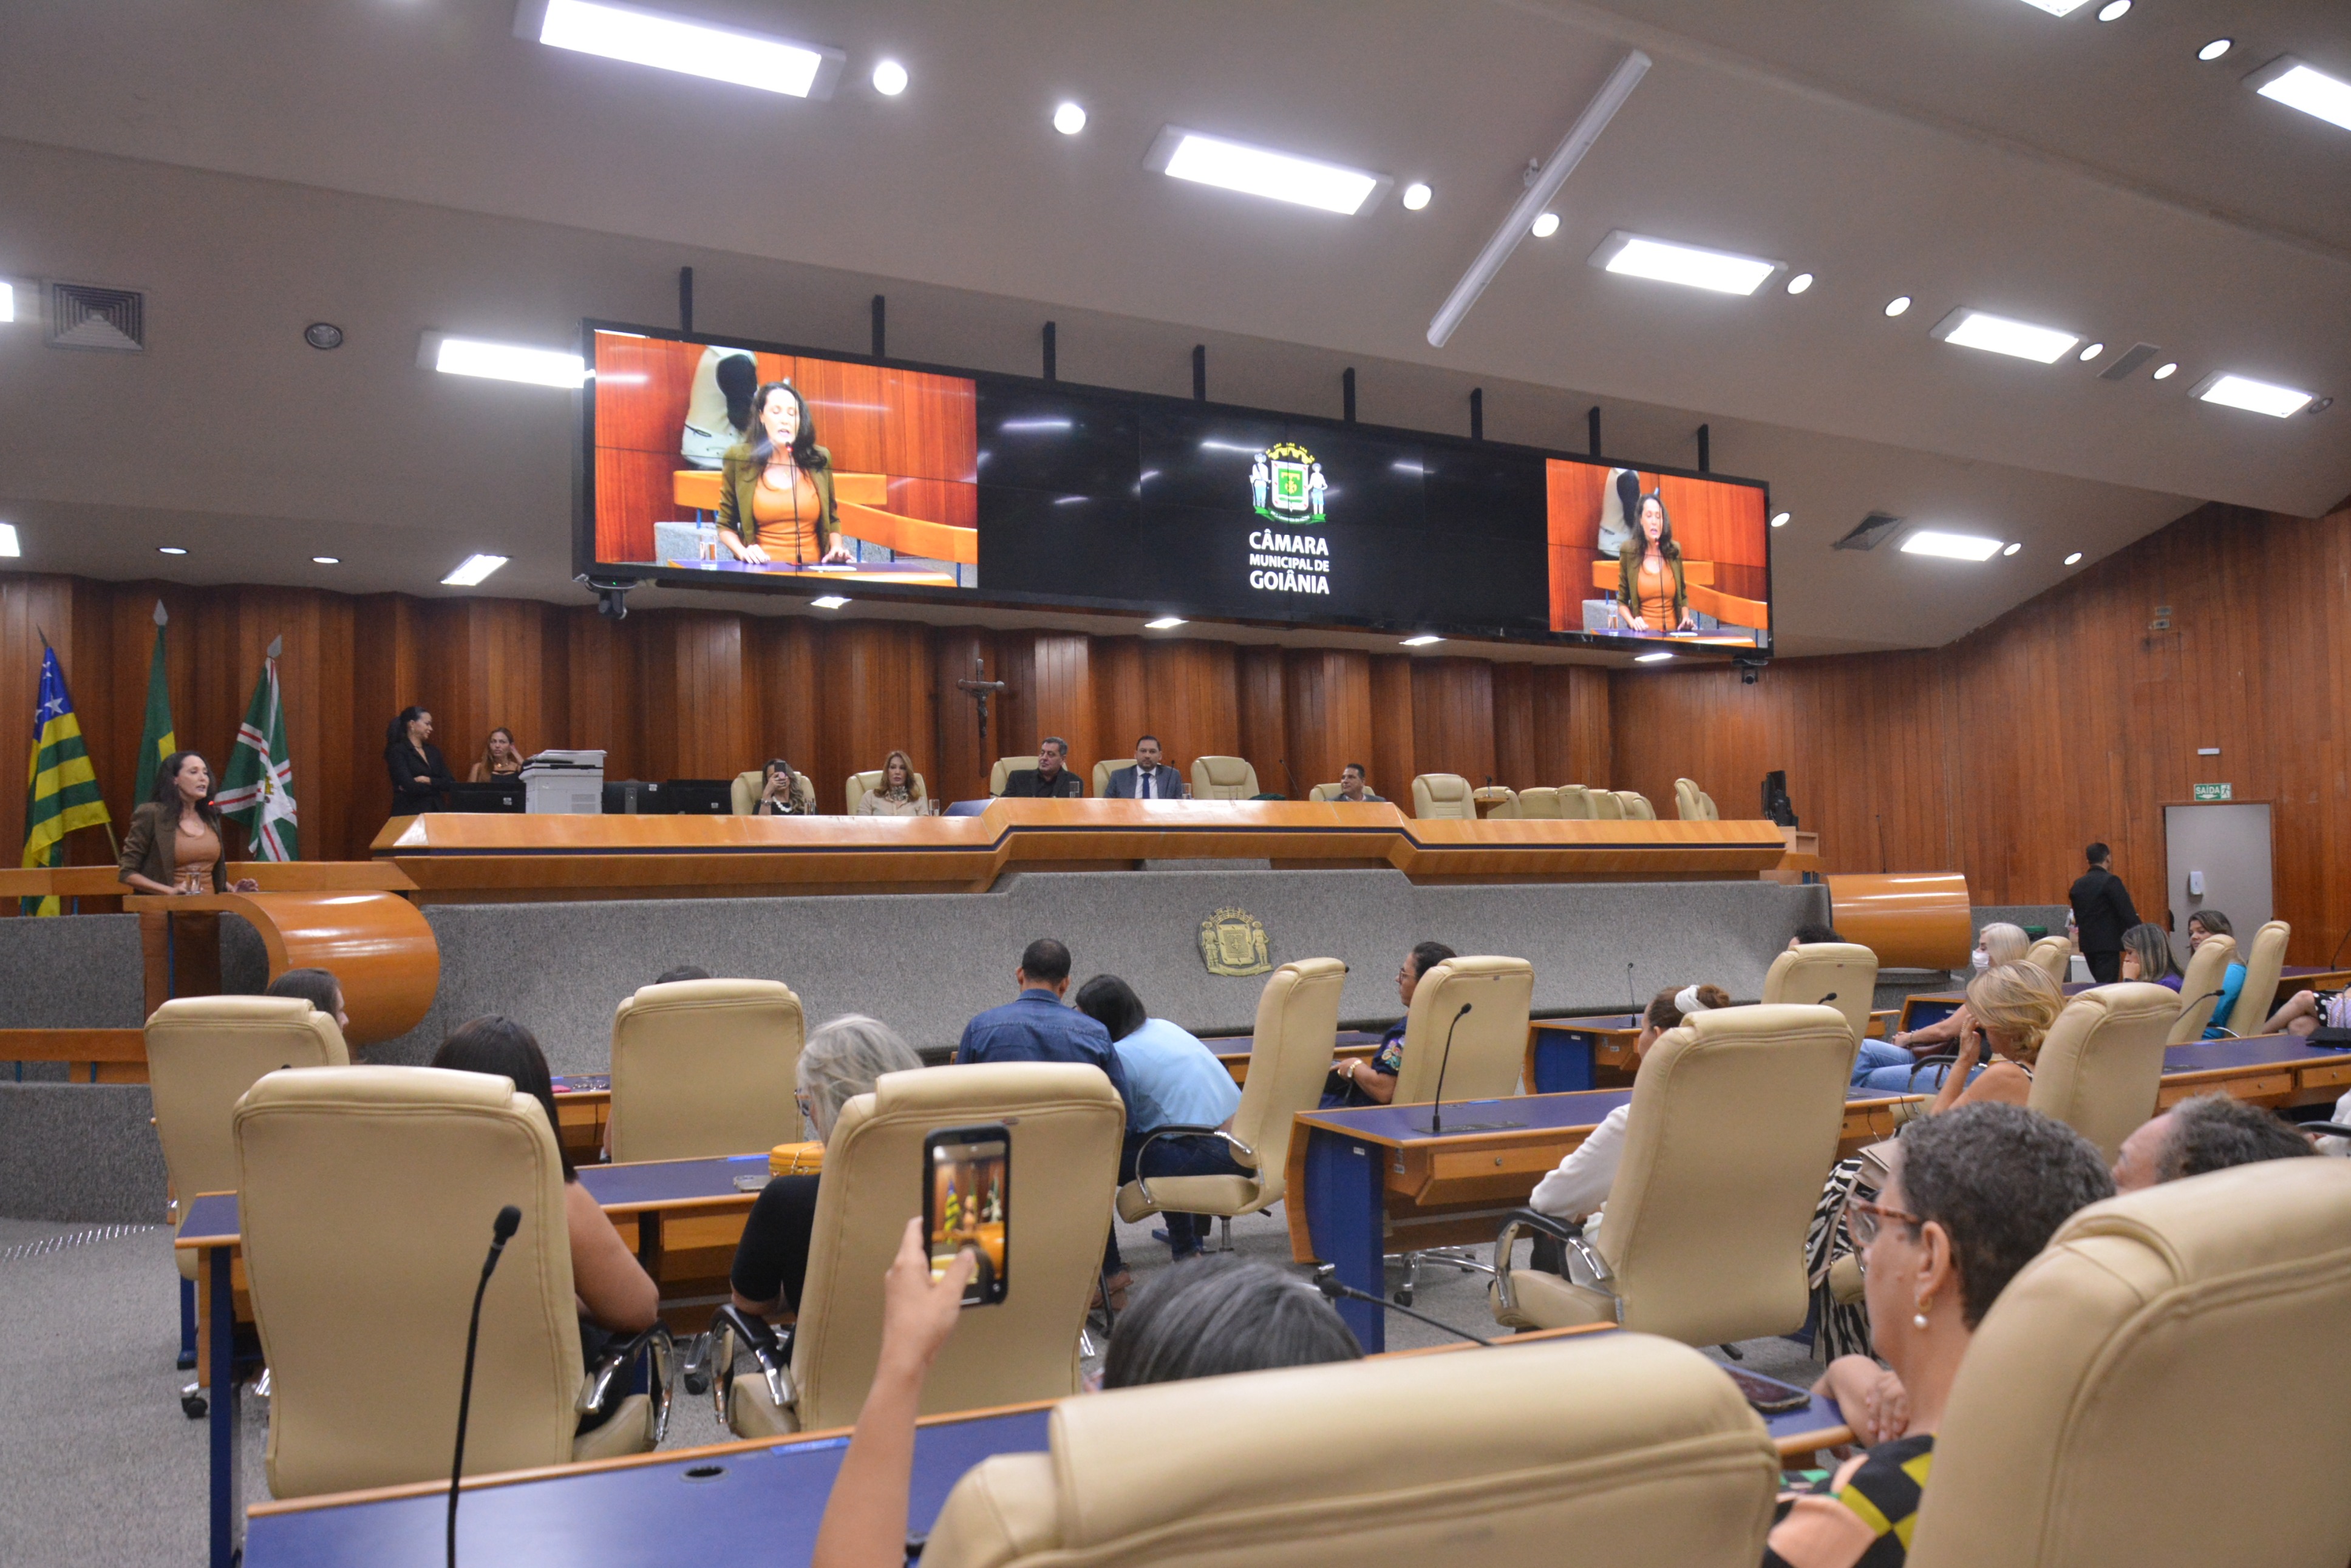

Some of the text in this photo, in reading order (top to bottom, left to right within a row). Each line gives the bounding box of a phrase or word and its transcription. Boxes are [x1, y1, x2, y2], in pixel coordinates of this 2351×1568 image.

[1249, 528, 1329, 556] CÂMARA
[1249, 553, 1330, 572] MUNICIPAL DE
[1250, 569, 1330, 595] GOIÂNIA
[2196, 785, 2220, 795] SAÍDA
